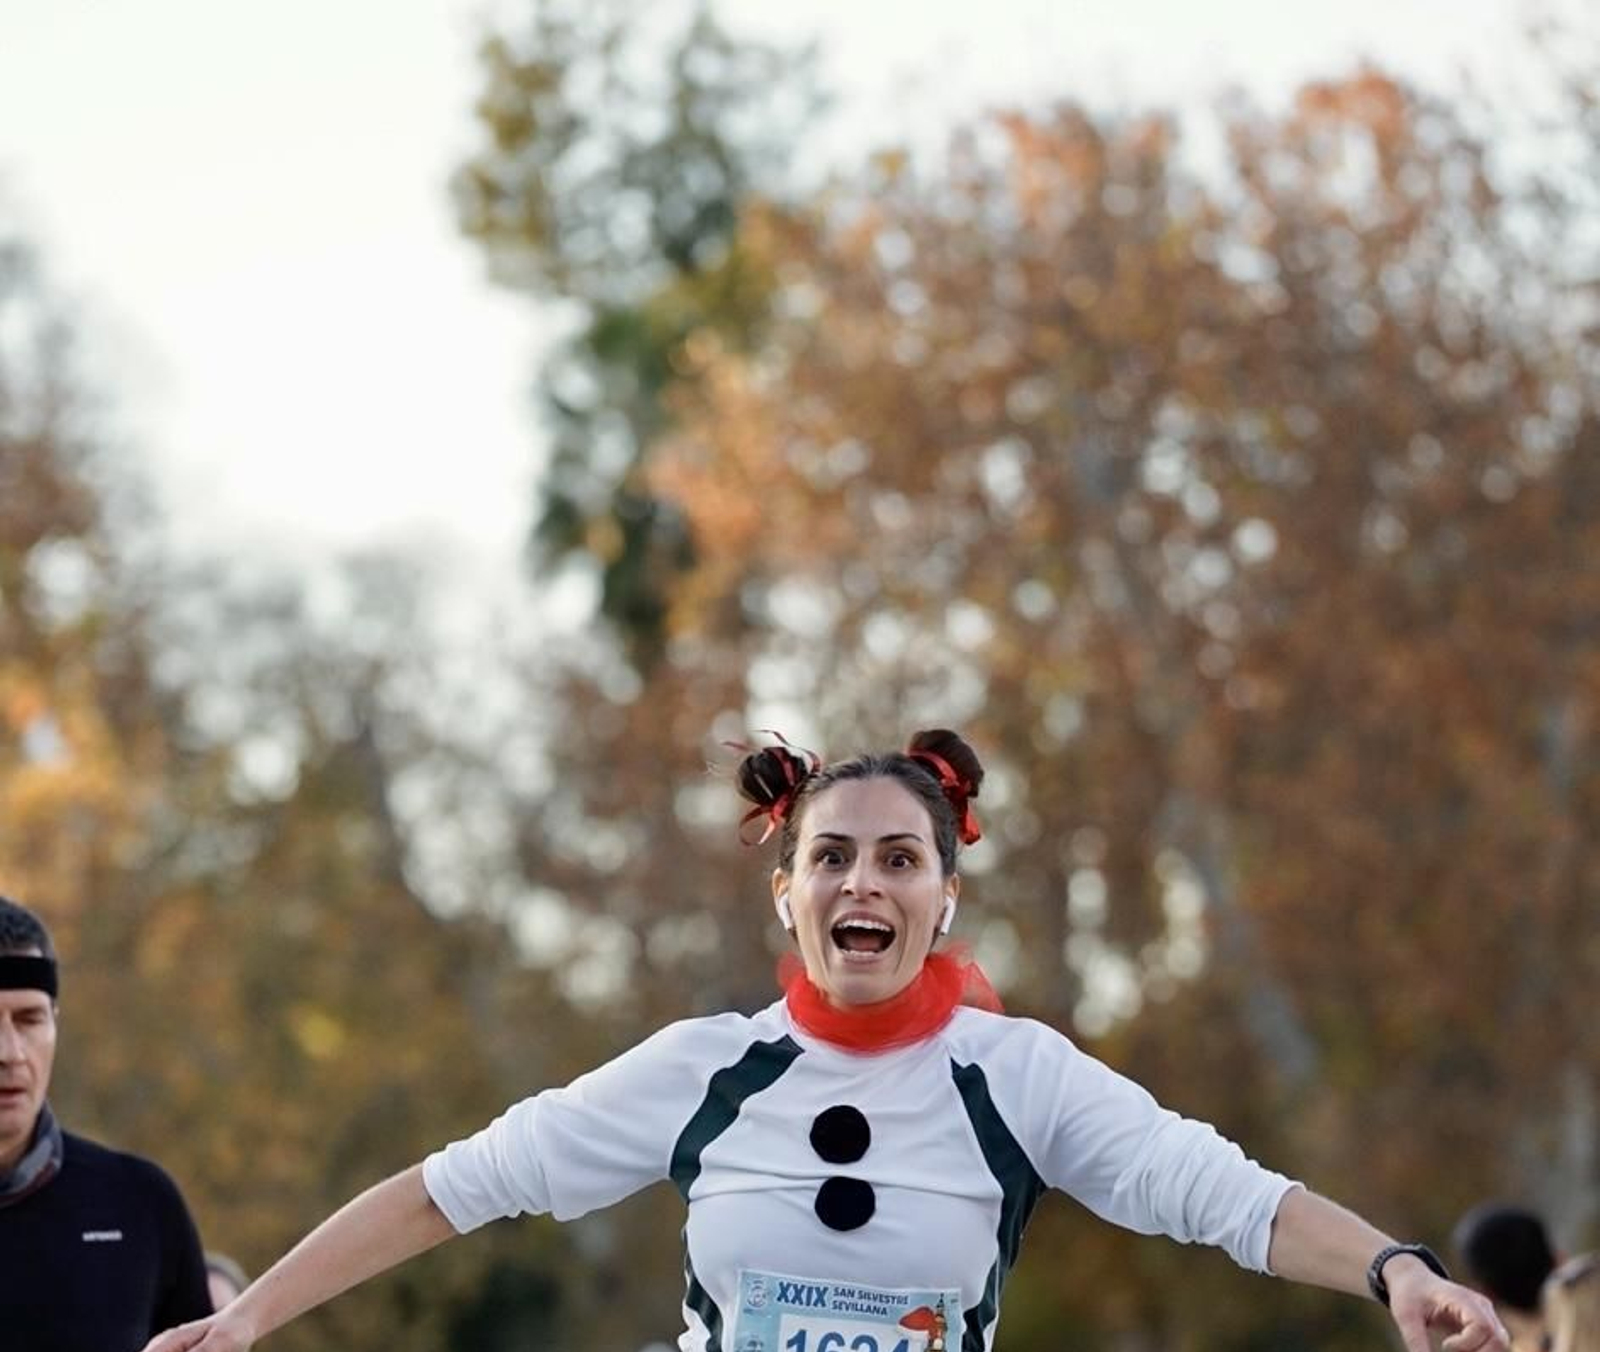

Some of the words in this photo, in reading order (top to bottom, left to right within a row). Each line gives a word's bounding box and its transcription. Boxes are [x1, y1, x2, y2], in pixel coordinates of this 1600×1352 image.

[777, 1281, 829, 1308] XXIX
[833, 1286, 856, 1300] SAN
[858, 1290, 909, 1305] SILVESTRE
[832, 1300, 888, 1316] SEVILLANA
